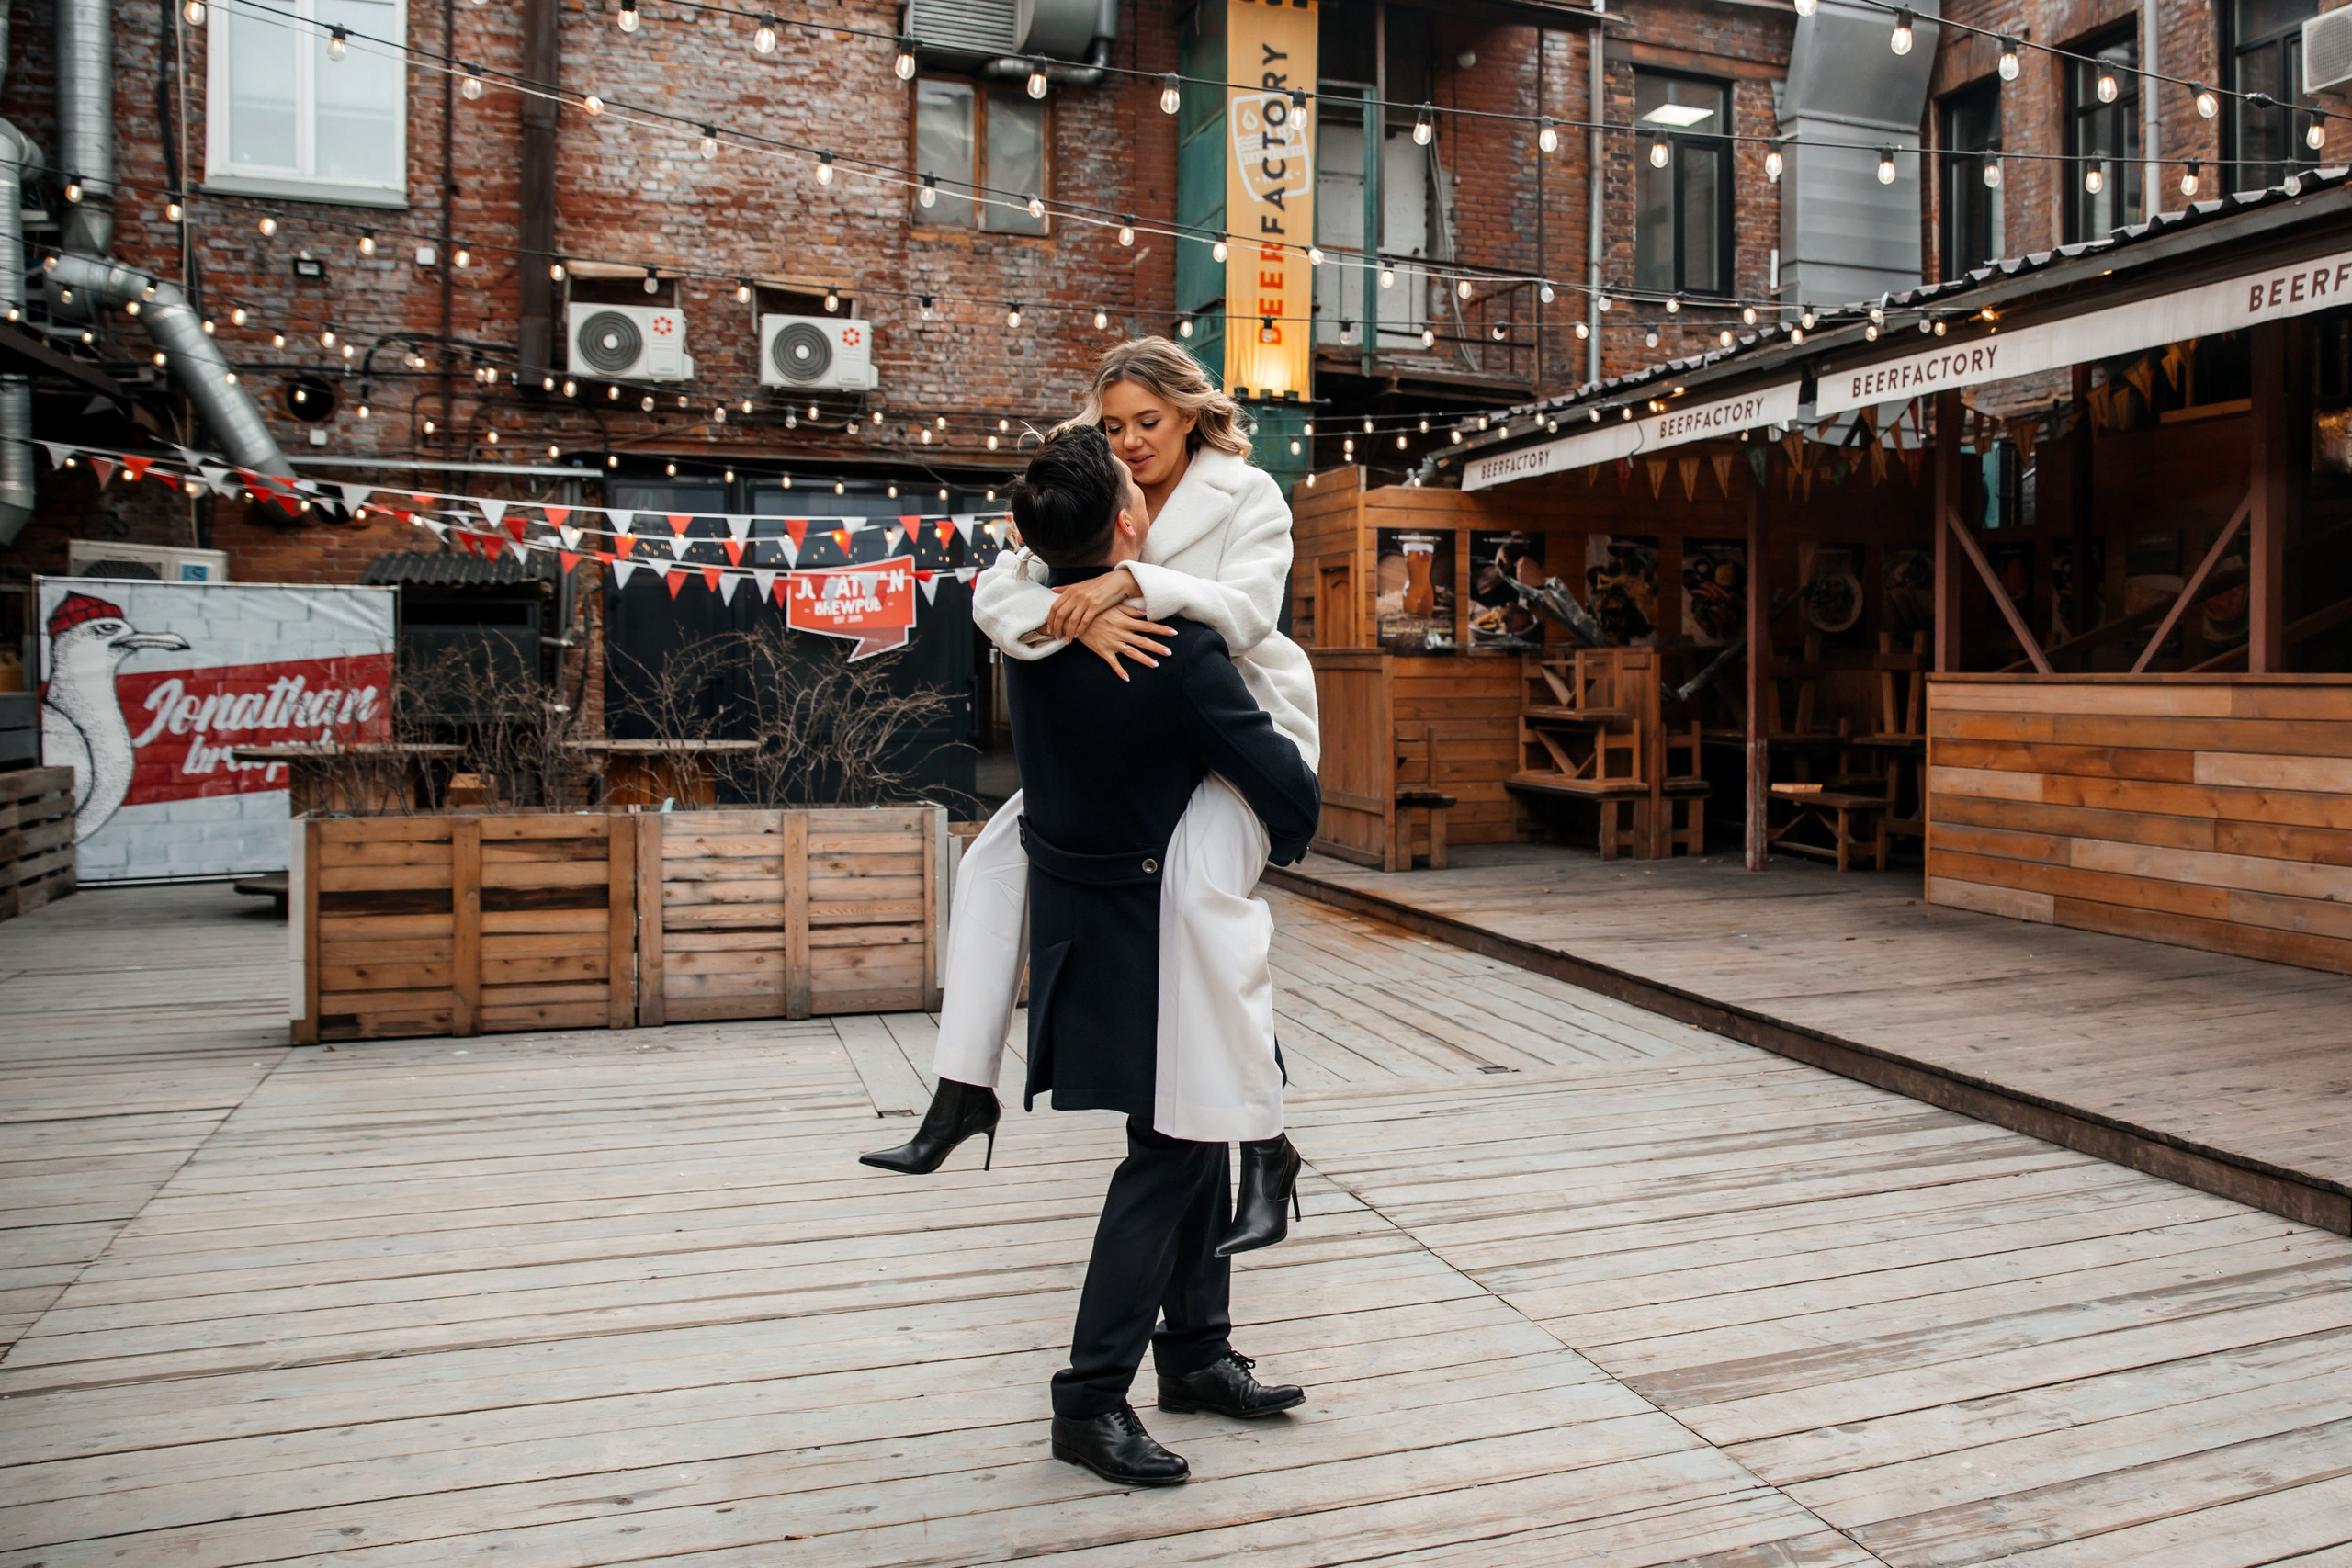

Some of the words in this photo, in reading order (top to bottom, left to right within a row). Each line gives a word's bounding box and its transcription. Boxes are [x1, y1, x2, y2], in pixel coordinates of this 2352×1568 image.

[1259, 42, 1288, 346] BEERFACTORY
[1852, 344, 1998, 398] BEERFACTORY
[1659, 397, 1765, 439] BEERFACTORY
[1481, 448, 1551, 480] BEERFACTORY
[795, 569, 905, 599] JOATN
[131, 675, 379, 748] Jonathan
